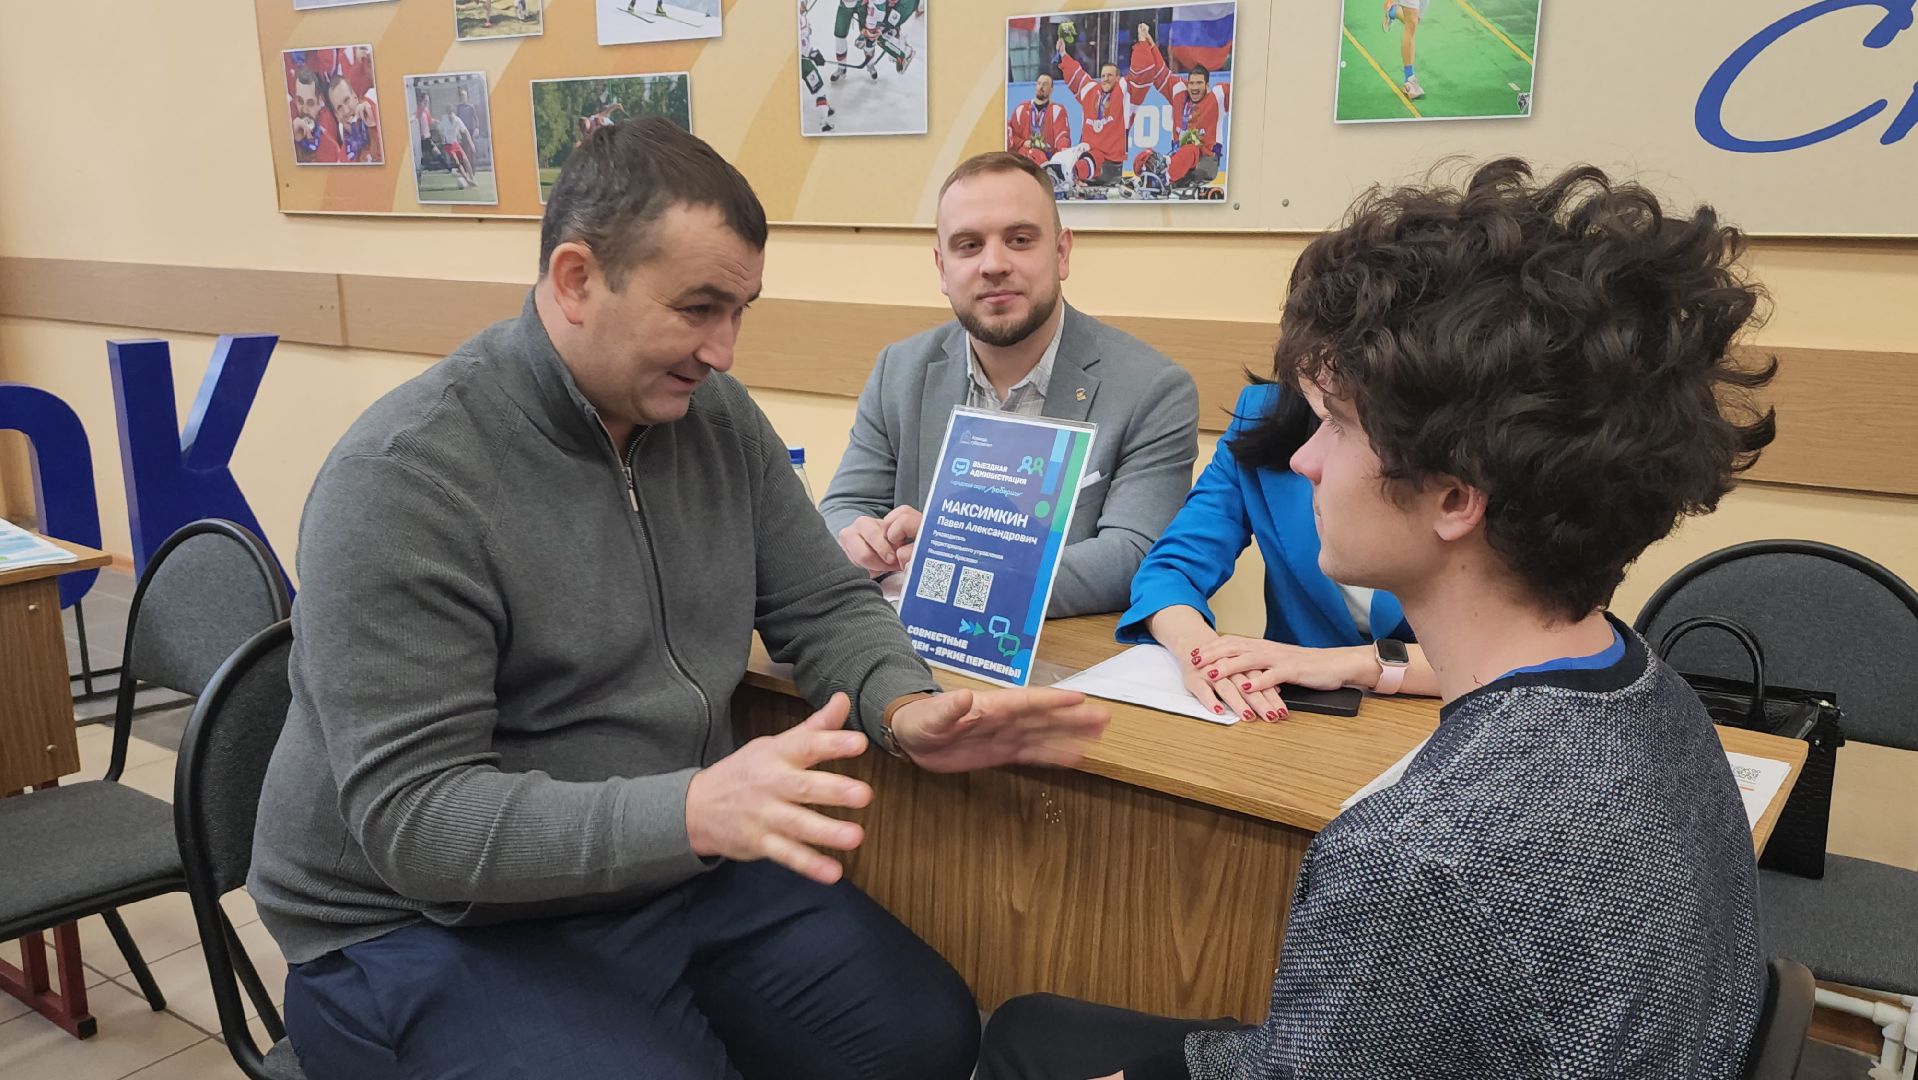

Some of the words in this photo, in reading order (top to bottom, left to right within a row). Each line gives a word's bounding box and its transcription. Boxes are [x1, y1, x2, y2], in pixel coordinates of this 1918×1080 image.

[1695, 0, 1918, 152] С
[969, 469, 1027, 485] АДМИНИСТРАЦИЯ
[972, 460, 1008, 473] ВЫЕЗДНАЯ
[941, 499, 1029, 528] МАКСИМКИН
[937, 515, 965, 529] Павел
[965, 521, 1038, 545] Александрович
[906, 625, 968, 649] СОВМЕСТНЫЕ
[911, 639, 930, 652] ДЕИ
[934, 646, 966, 663] ЯРКИЕ
